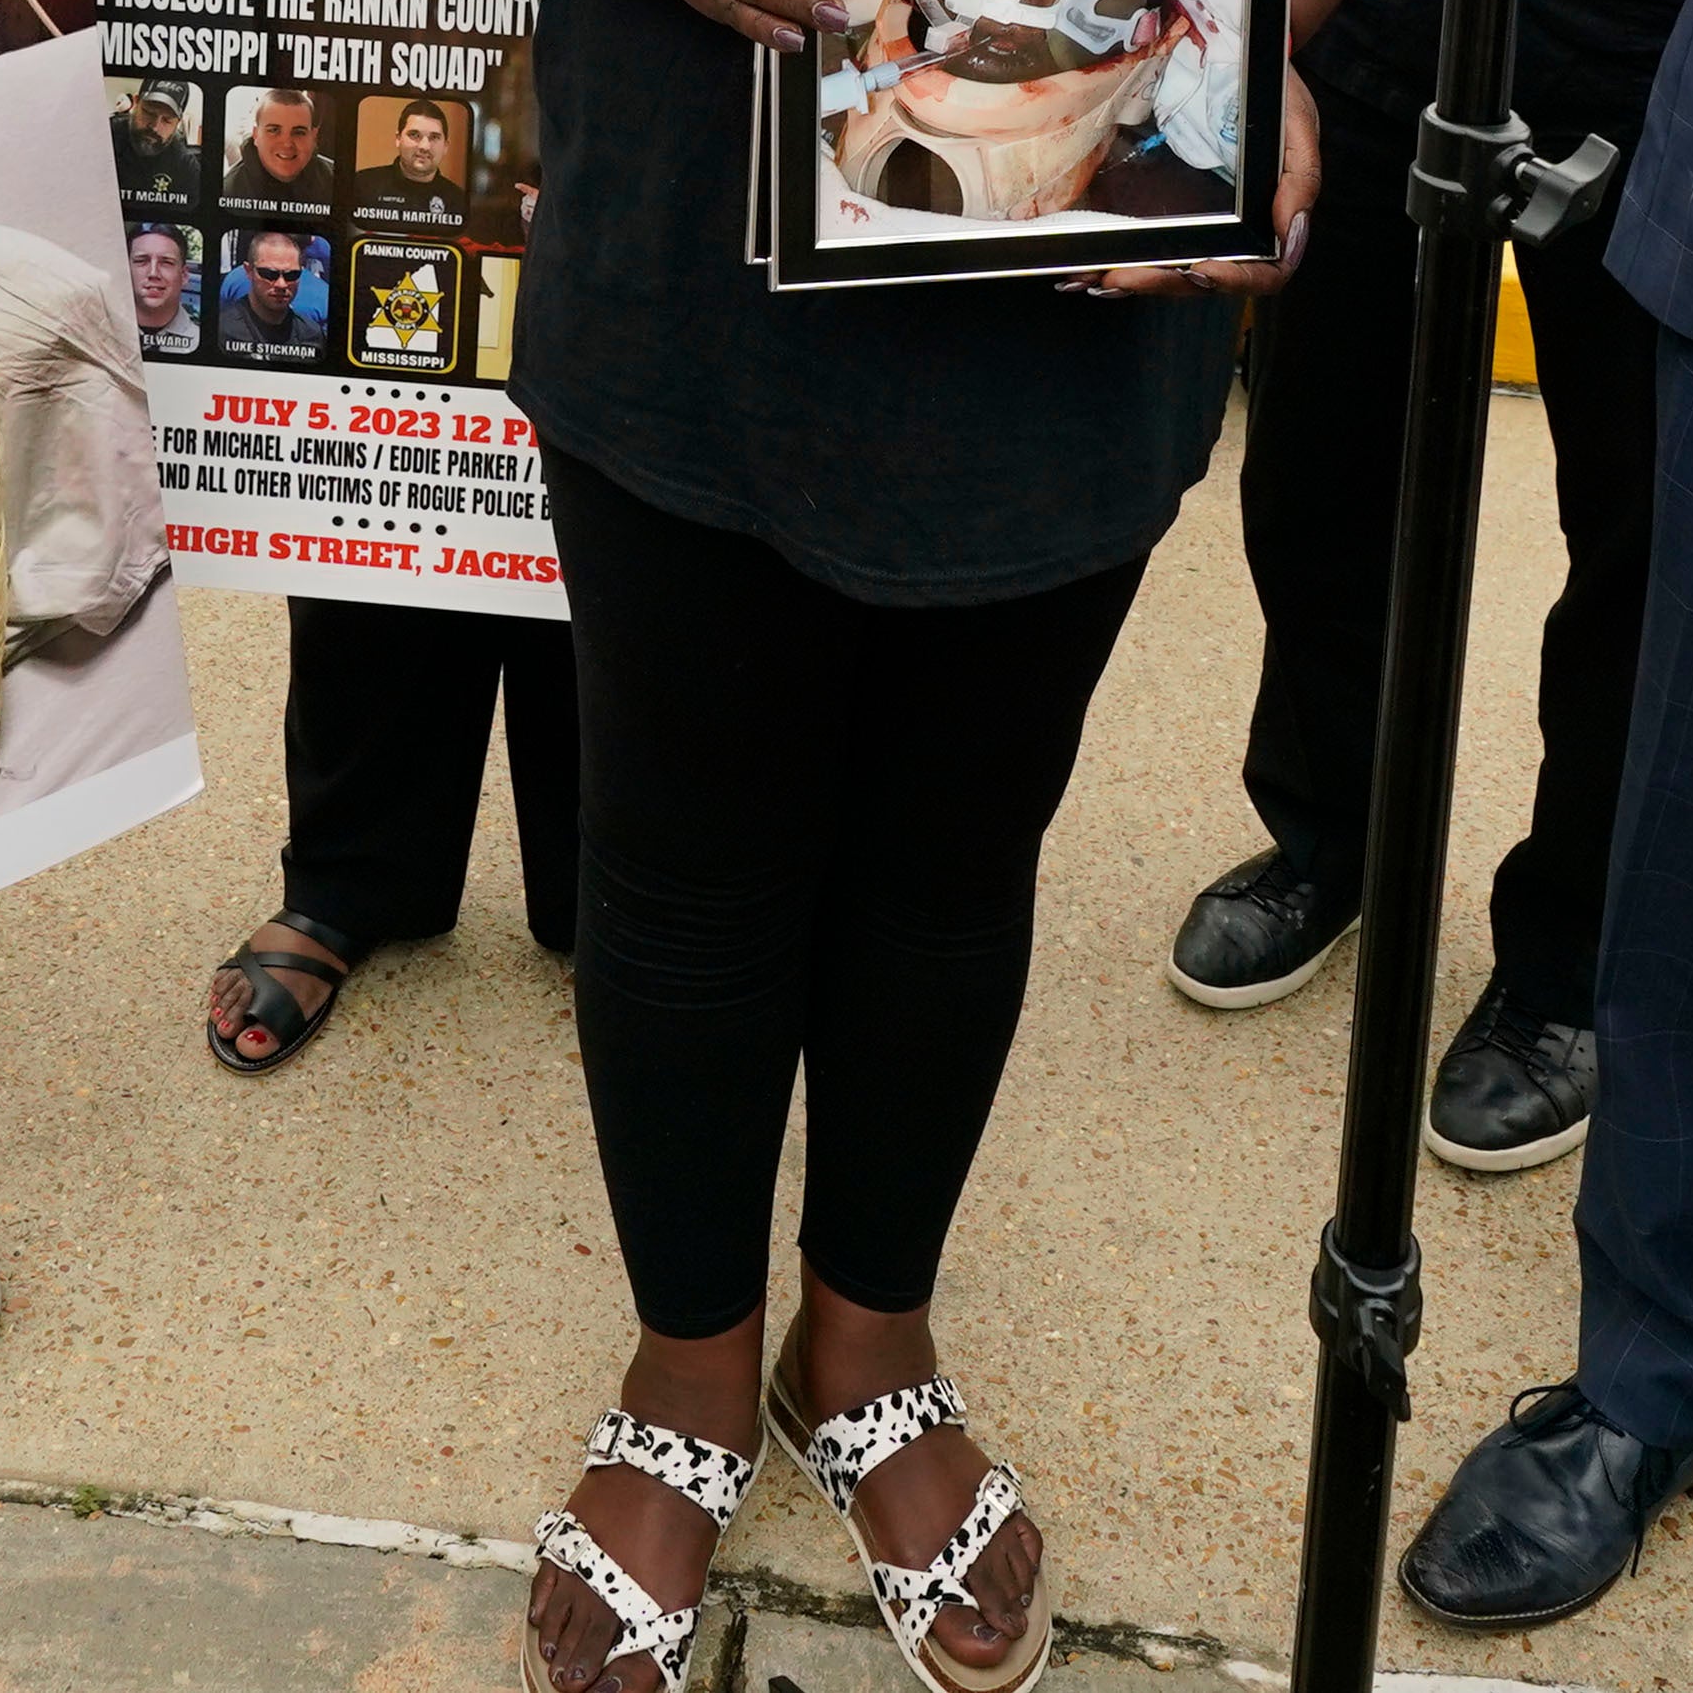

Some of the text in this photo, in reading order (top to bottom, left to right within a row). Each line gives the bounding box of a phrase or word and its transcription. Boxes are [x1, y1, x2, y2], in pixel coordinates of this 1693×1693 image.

[96, 19, 503, 92] MISSISSIPPI "DEATH SQUAD"
[135, 190, 188, 204] MCALPIN
[218, 196, 331, 216] CHRISTIAN DEDMON
[353, 207, 463, 226] JOSHUA HARTFIELD
[363, 244, 449, 261] RANKIN COUNTY
[143, 334, 191, 348] ELWARD
[225, 340, 316, 358] LUKE STICKMAN
[361, 351, 445, 368] MISSISSIPPI
[203, 393, 299, 427] JULY
[349, 405, 441, 439] 2023
[452, 414, 492, 444] 12
[163, 425, 197, 456] FOR
[203, 429, 284, 462] MICHAEL
[290, 437, 368, 470] JENKINS
[390, 444, 442, 475] EDDIE
[447, 450, 518, 483] PARKER
[196, 465, 228, 493] ALL
[235, 468, 291, 499] OTHER
[298, 473, 372, 506] VICTIMS
[379, 478, 402, 508] OF
[407, 480, 466, 513] ROGUE
[472, 488, 535, 520] POLICE
[165, 523, 565, 584] HIGH STREET, JACKS
